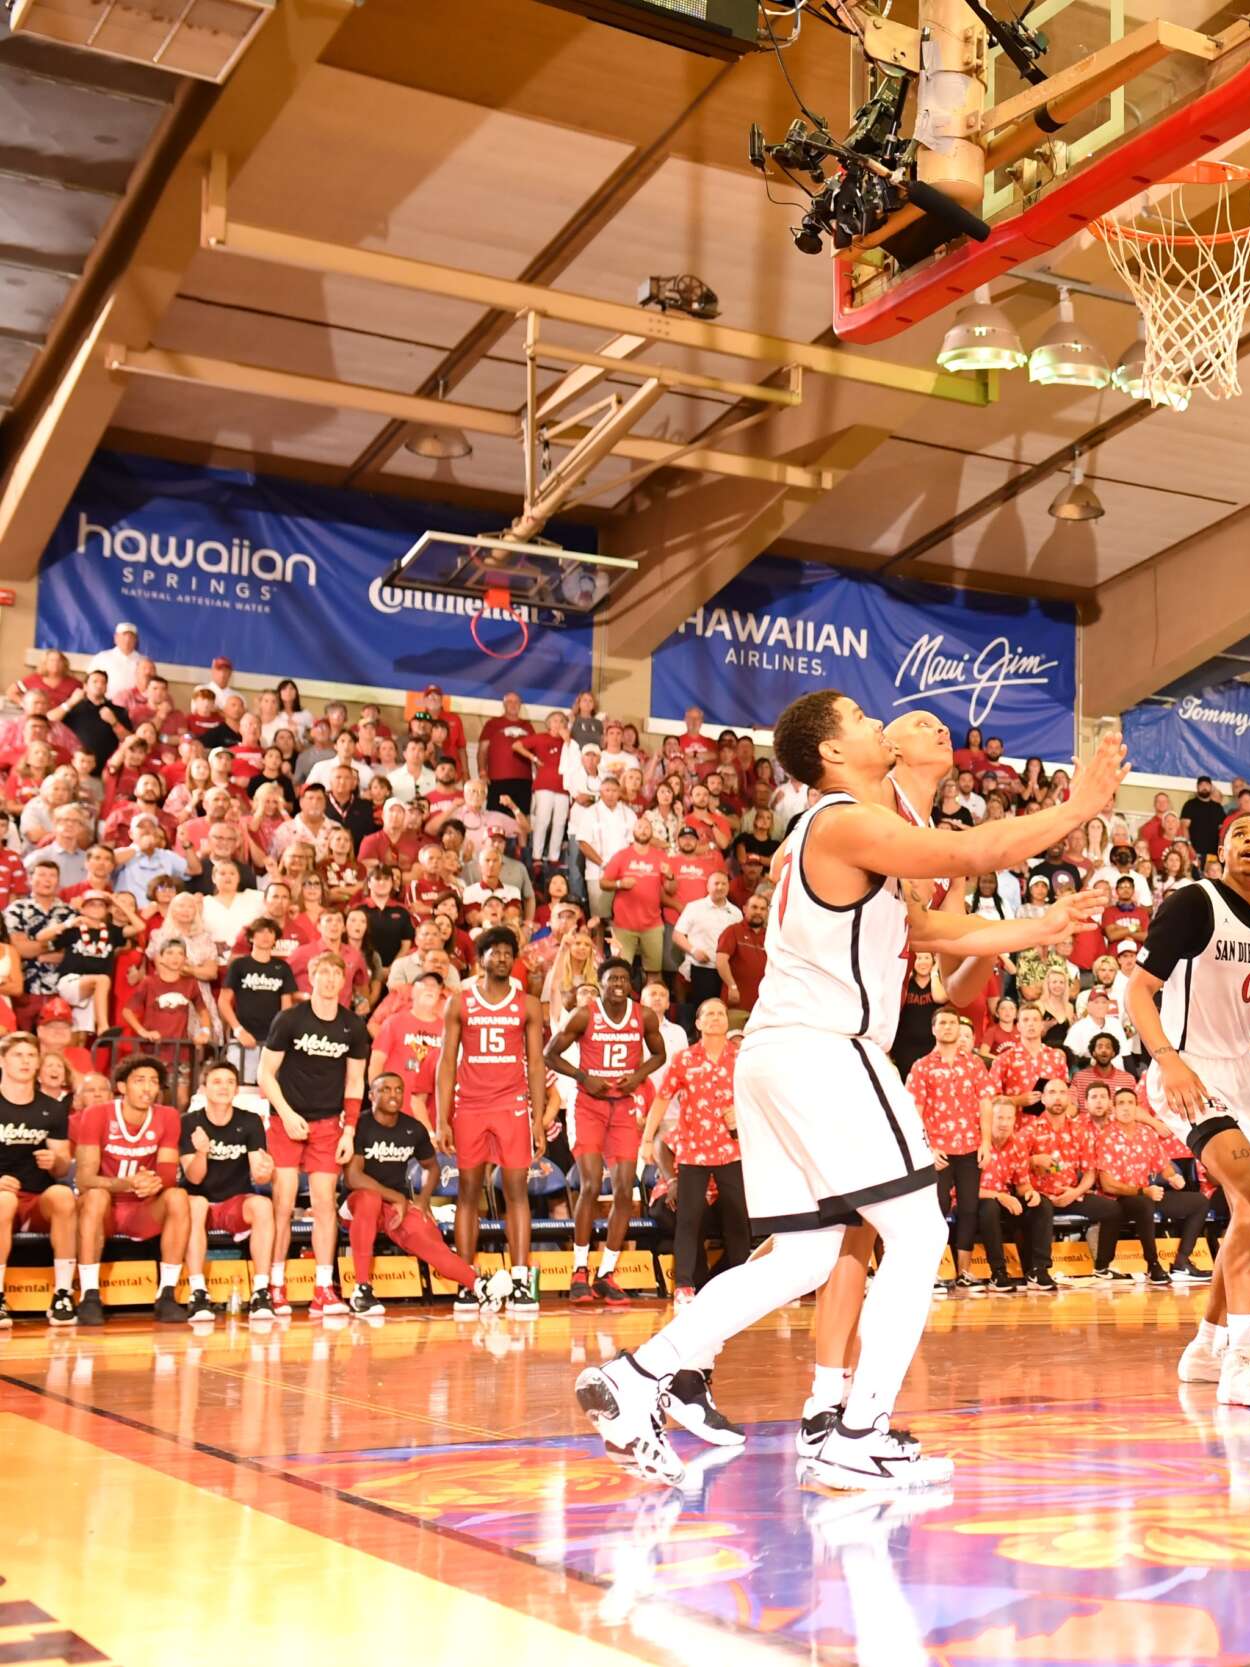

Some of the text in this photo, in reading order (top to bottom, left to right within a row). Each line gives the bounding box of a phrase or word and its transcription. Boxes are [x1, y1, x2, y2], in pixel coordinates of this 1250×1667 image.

[77, 512, 317, 587] hawaiian
[122, 567, 272, 600] SPRINGS
[121, 587, 271, 614] NATURAL ARTESIAN WATER
[895, 634, 1058, 727] Maui Jim
[1215, 939, 1236, 961] SAN
[480, 1028, 505, 1053] 15
[603, 1043, 627, 1067] 12
